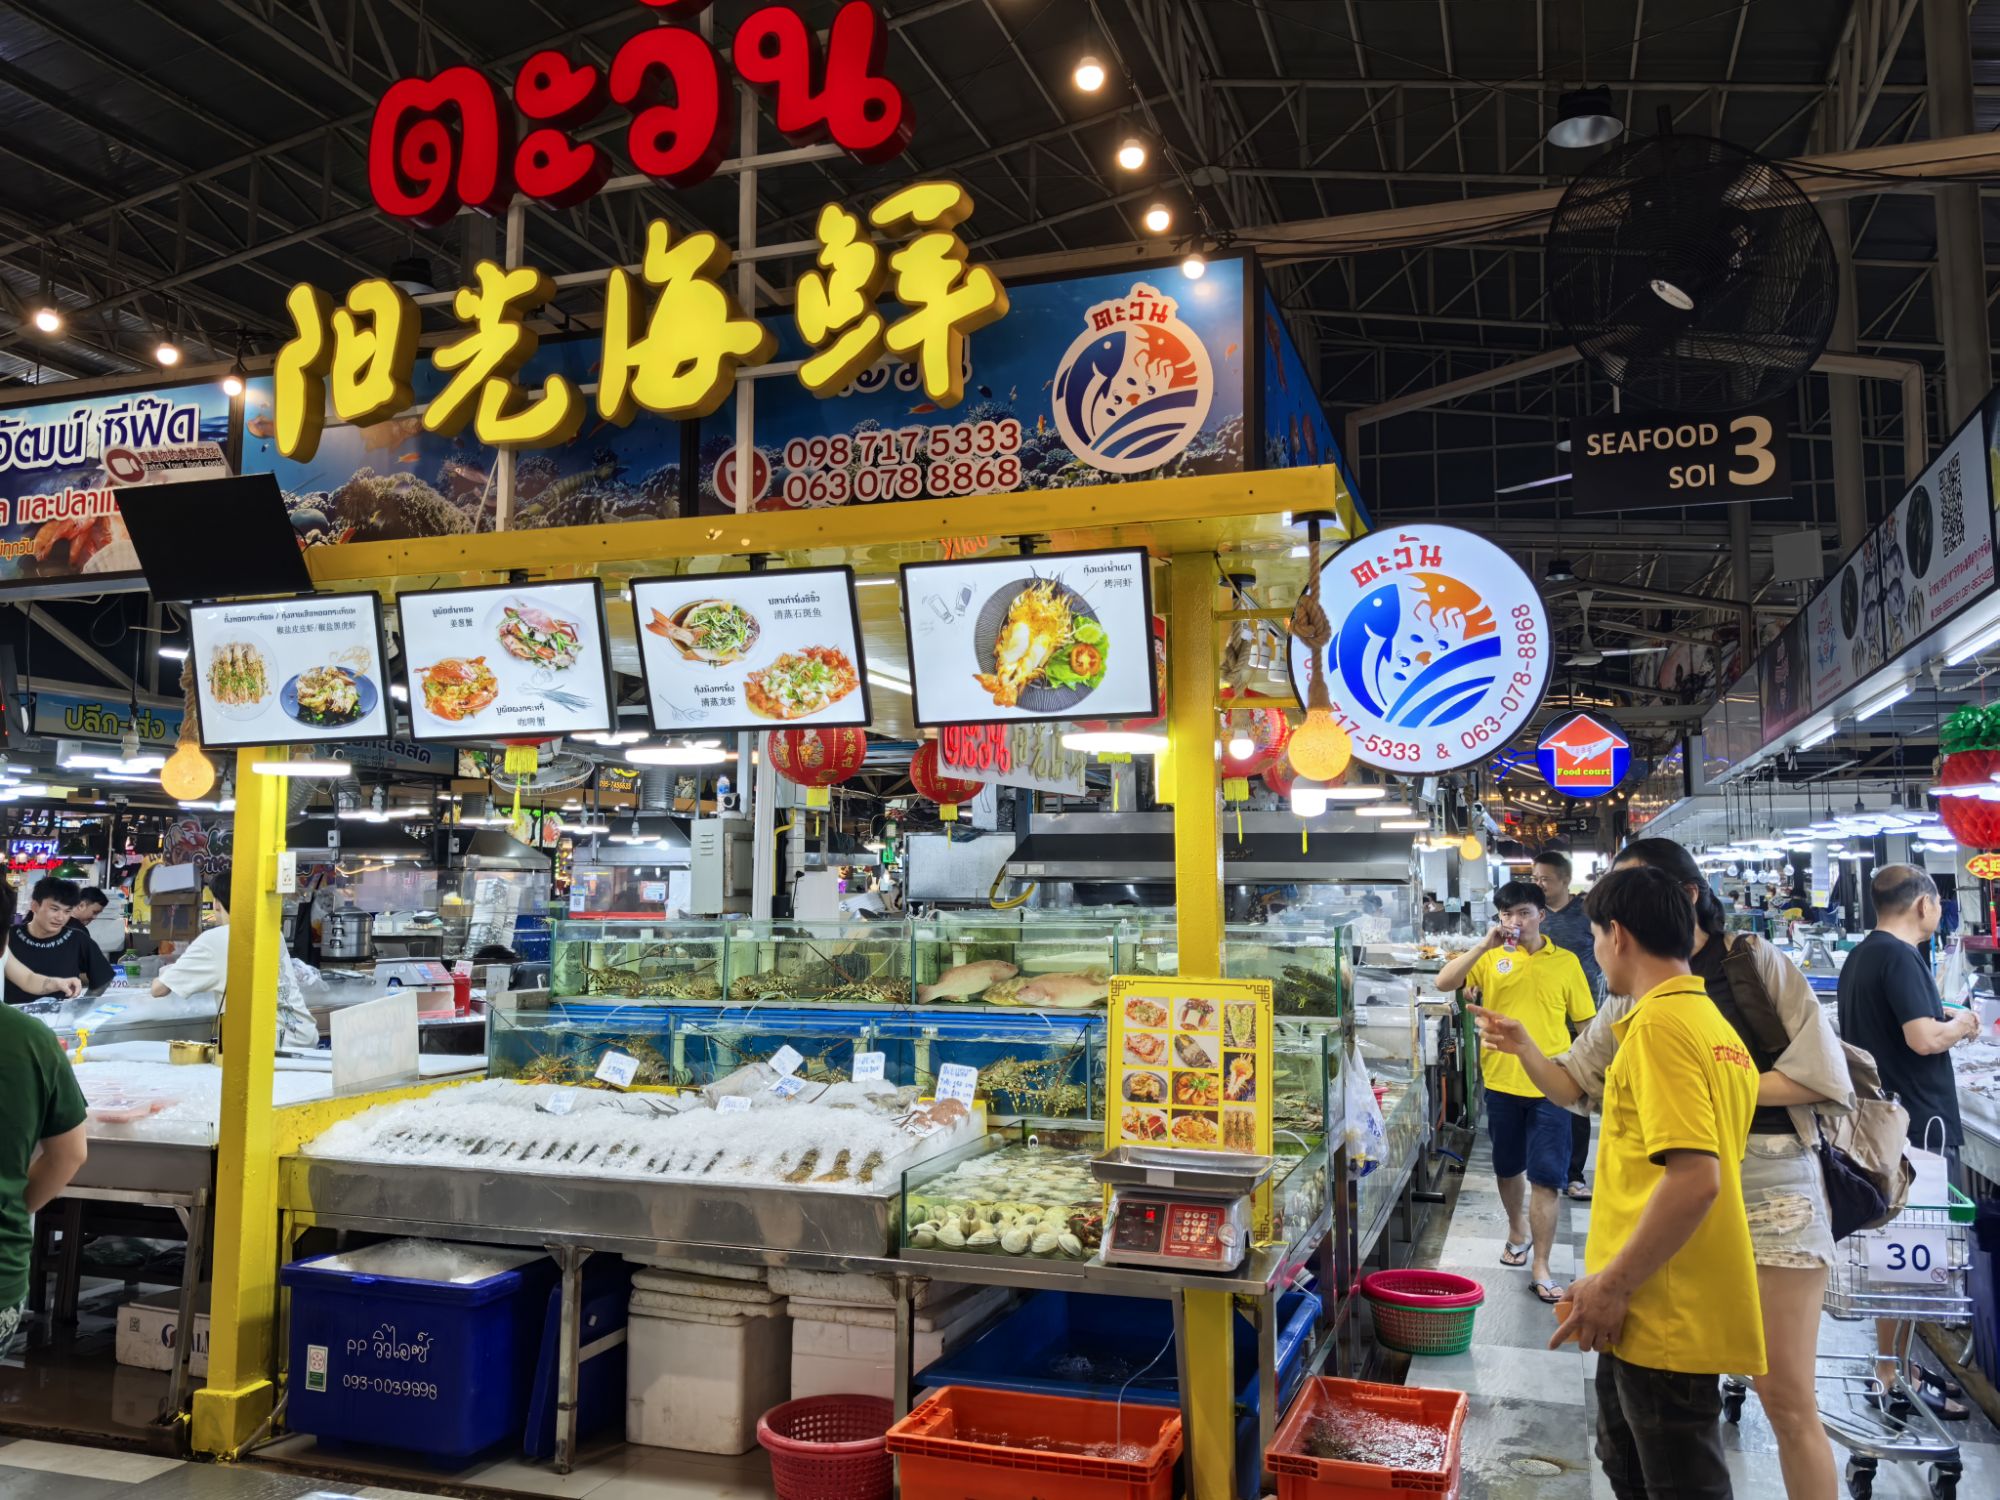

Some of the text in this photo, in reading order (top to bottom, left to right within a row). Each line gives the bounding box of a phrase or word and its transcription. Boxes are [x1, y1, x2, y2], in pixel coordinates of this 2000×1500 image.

[367, 0, 907, 222] ตะวน
[274, 181, 1007, 461] 阳光海鲜
[1091, 289, 1169, 332] ตะวัน
[787, 422, 1019, 468] 098 717 5333
[1587, 424, 1719, 456] SEAFOOD
[1669, 415, 1777, 489] SOI 3
[786, 458, 1019, 503] 063 078 8868
[18, 488, 121, 523] และปลาแ
[1350, 533, 1443, 588] ตะวัน
[1435, 742, 1451, 759] &
[1460, 603, 1537, 750] 063-078-8868
[1557, 767, 1611, 776] Food court
[1887, 1243, 1931, 1272] 30
[343, 1374, 437, 1400] 093-0039898
